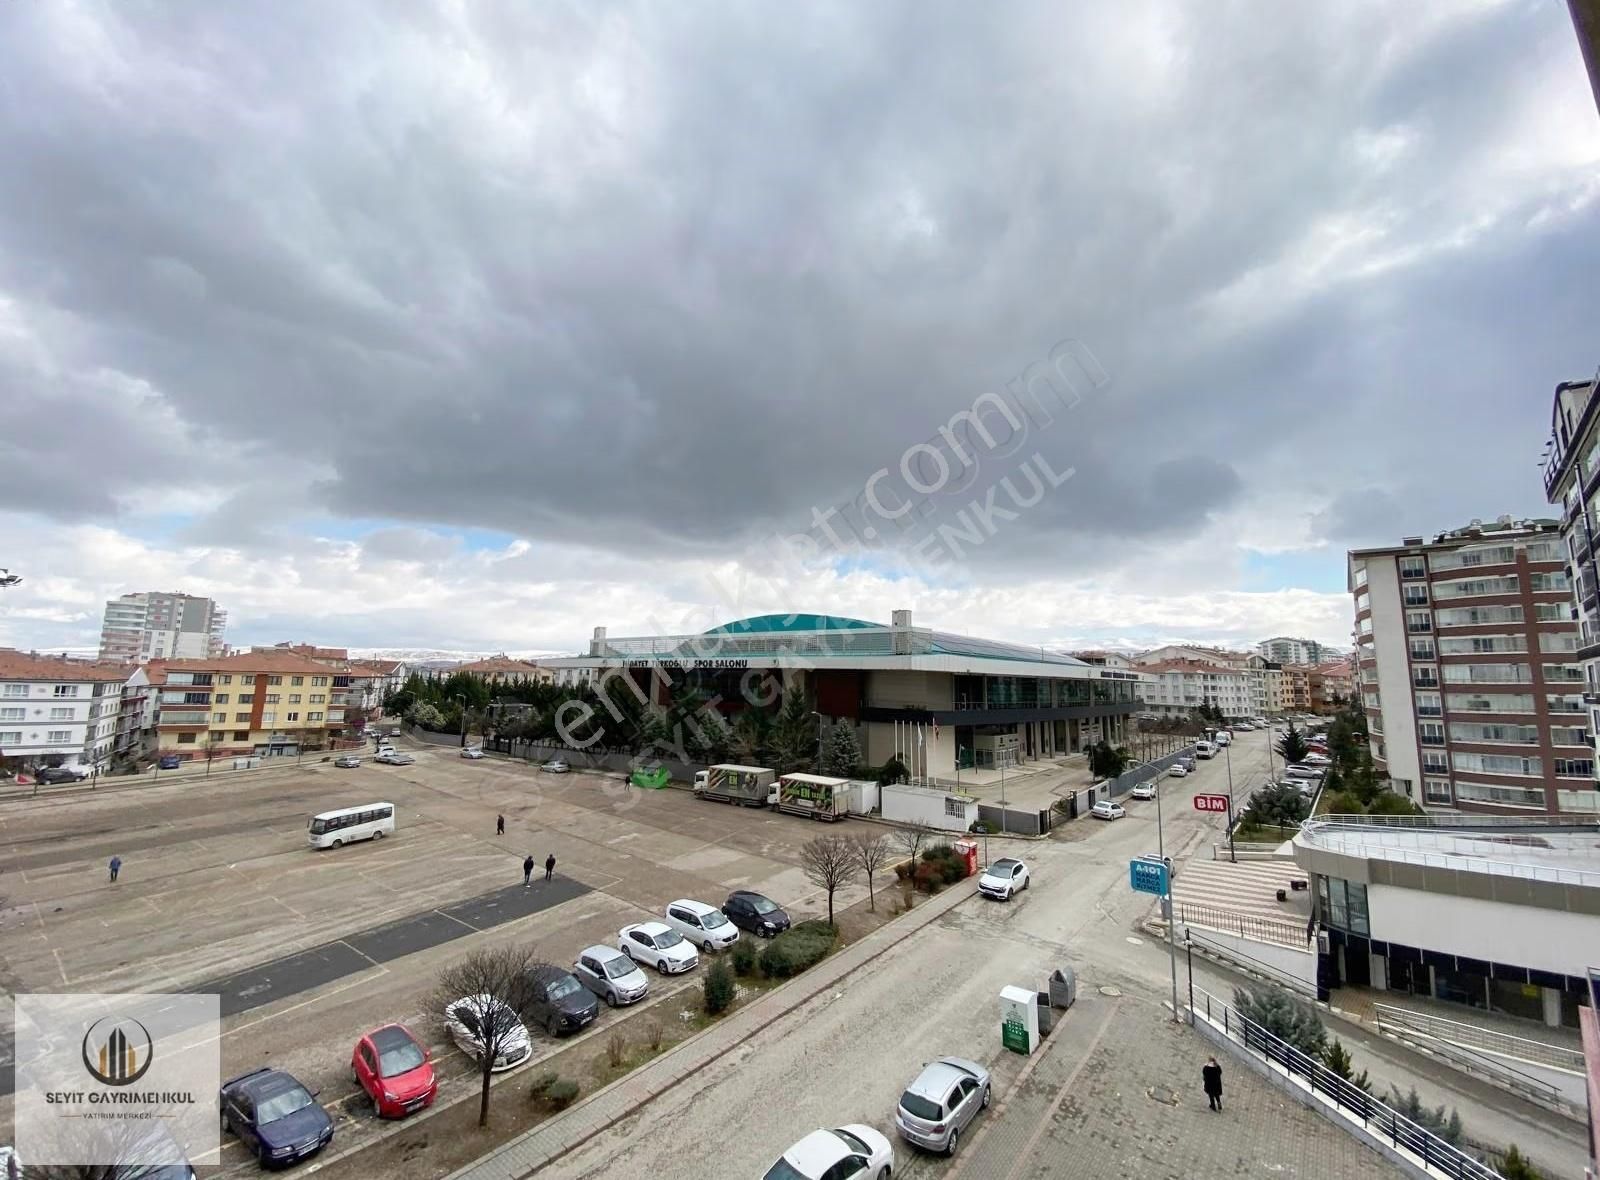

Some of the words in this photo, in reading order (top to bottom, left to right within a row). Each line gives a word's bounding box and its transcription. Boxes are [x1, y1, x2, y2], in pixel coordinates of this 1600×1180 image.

[694, 659, 713, 668] SPOR
[715, 659, 748, 668] SALONU
[1197, 796, 1224, 810] BİM
